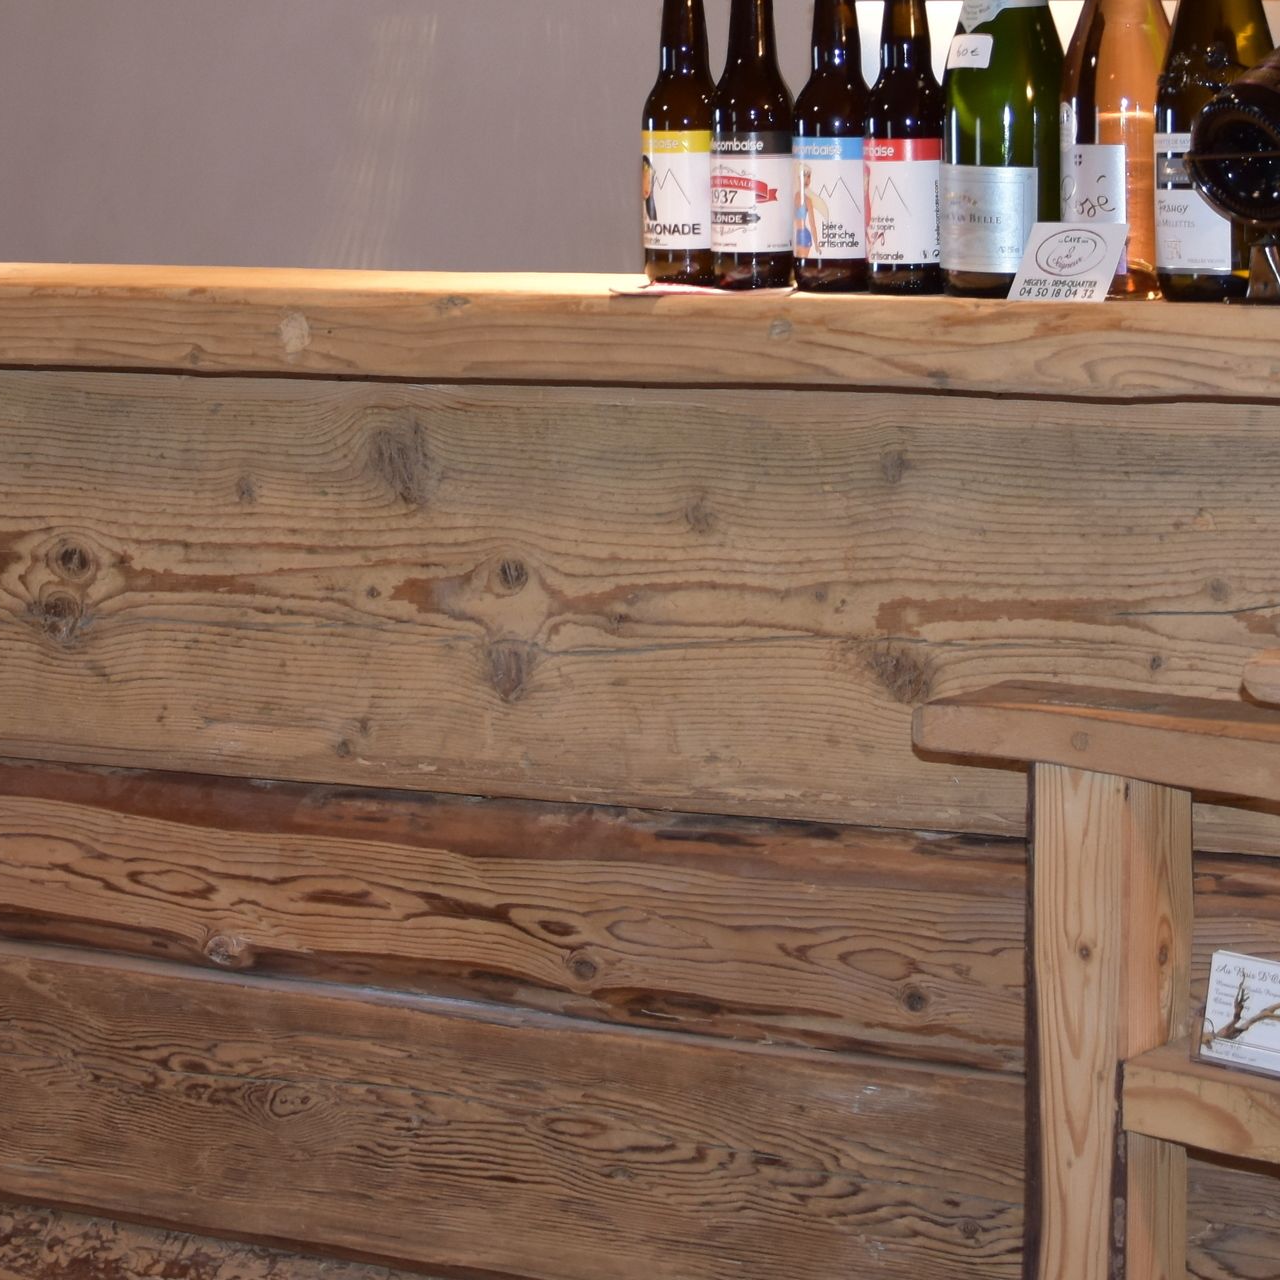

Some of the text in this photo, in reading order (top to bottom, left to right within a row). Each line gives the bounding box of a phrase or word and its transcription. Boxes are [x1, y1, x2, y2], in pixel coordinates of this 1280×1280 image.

[822, 221, 844, 231] bière
[821, 230, 856, 240] blanche
[1063, 235, 1081, 244] CAVE
[818, 238, 860, 248] artisanale
[1019, 287, 1094, 299] 04 50 18 04 32
